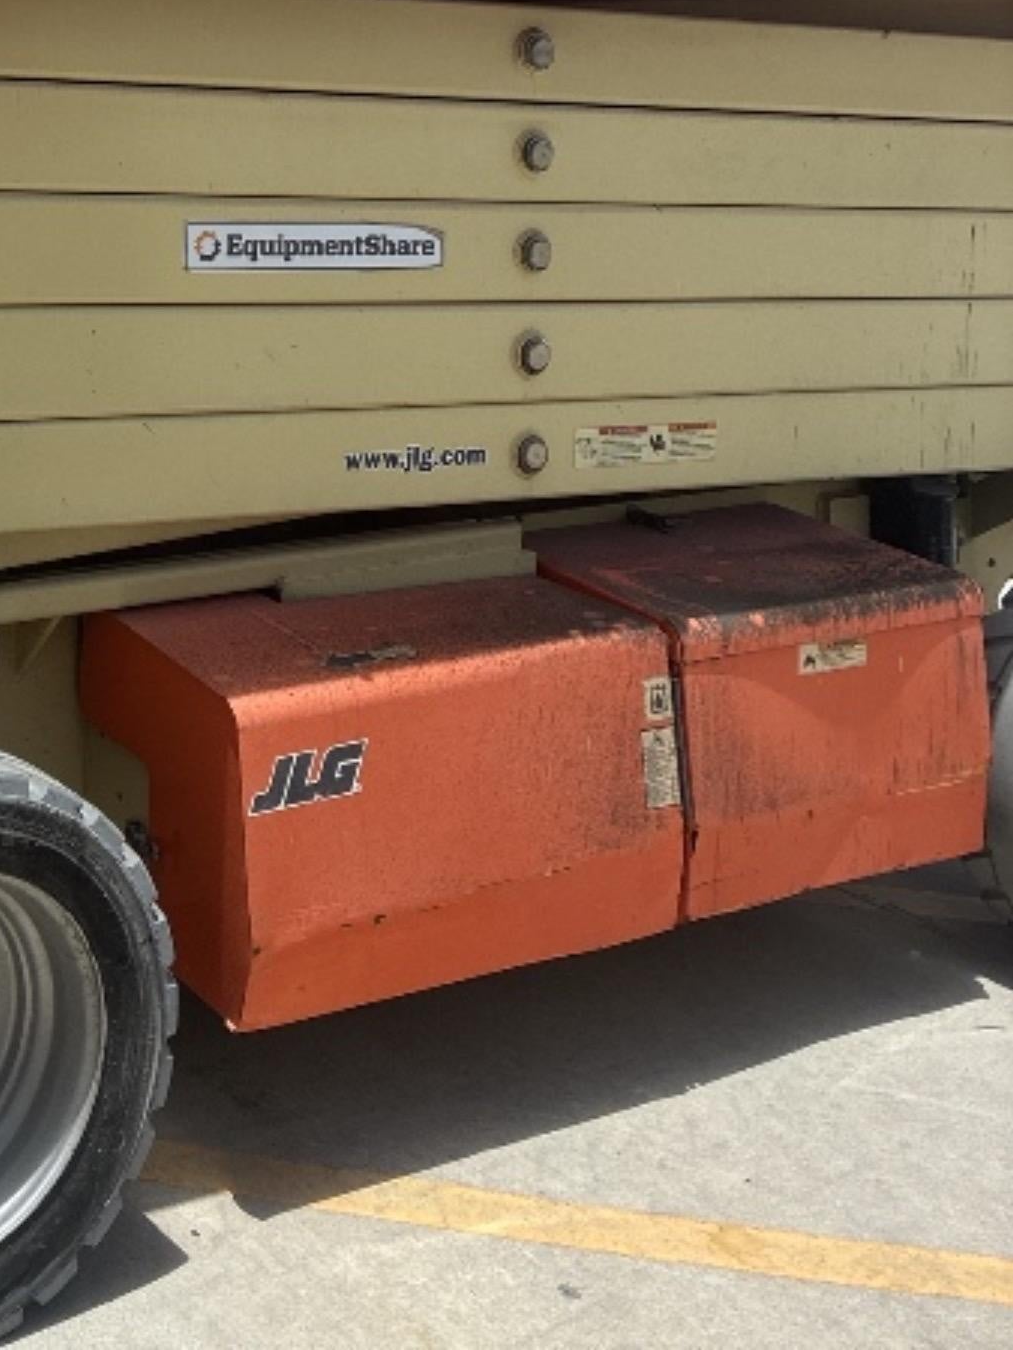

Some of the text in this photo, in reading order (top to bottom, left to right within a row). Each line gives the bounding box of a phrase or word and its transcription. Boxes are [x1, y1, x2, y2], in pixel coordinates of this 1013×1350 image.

[226, 232, 436, 263] EquipmentShare
[344, 446, 487, 473] www.jlg.com
[248, 737, 368, 817] JLG
